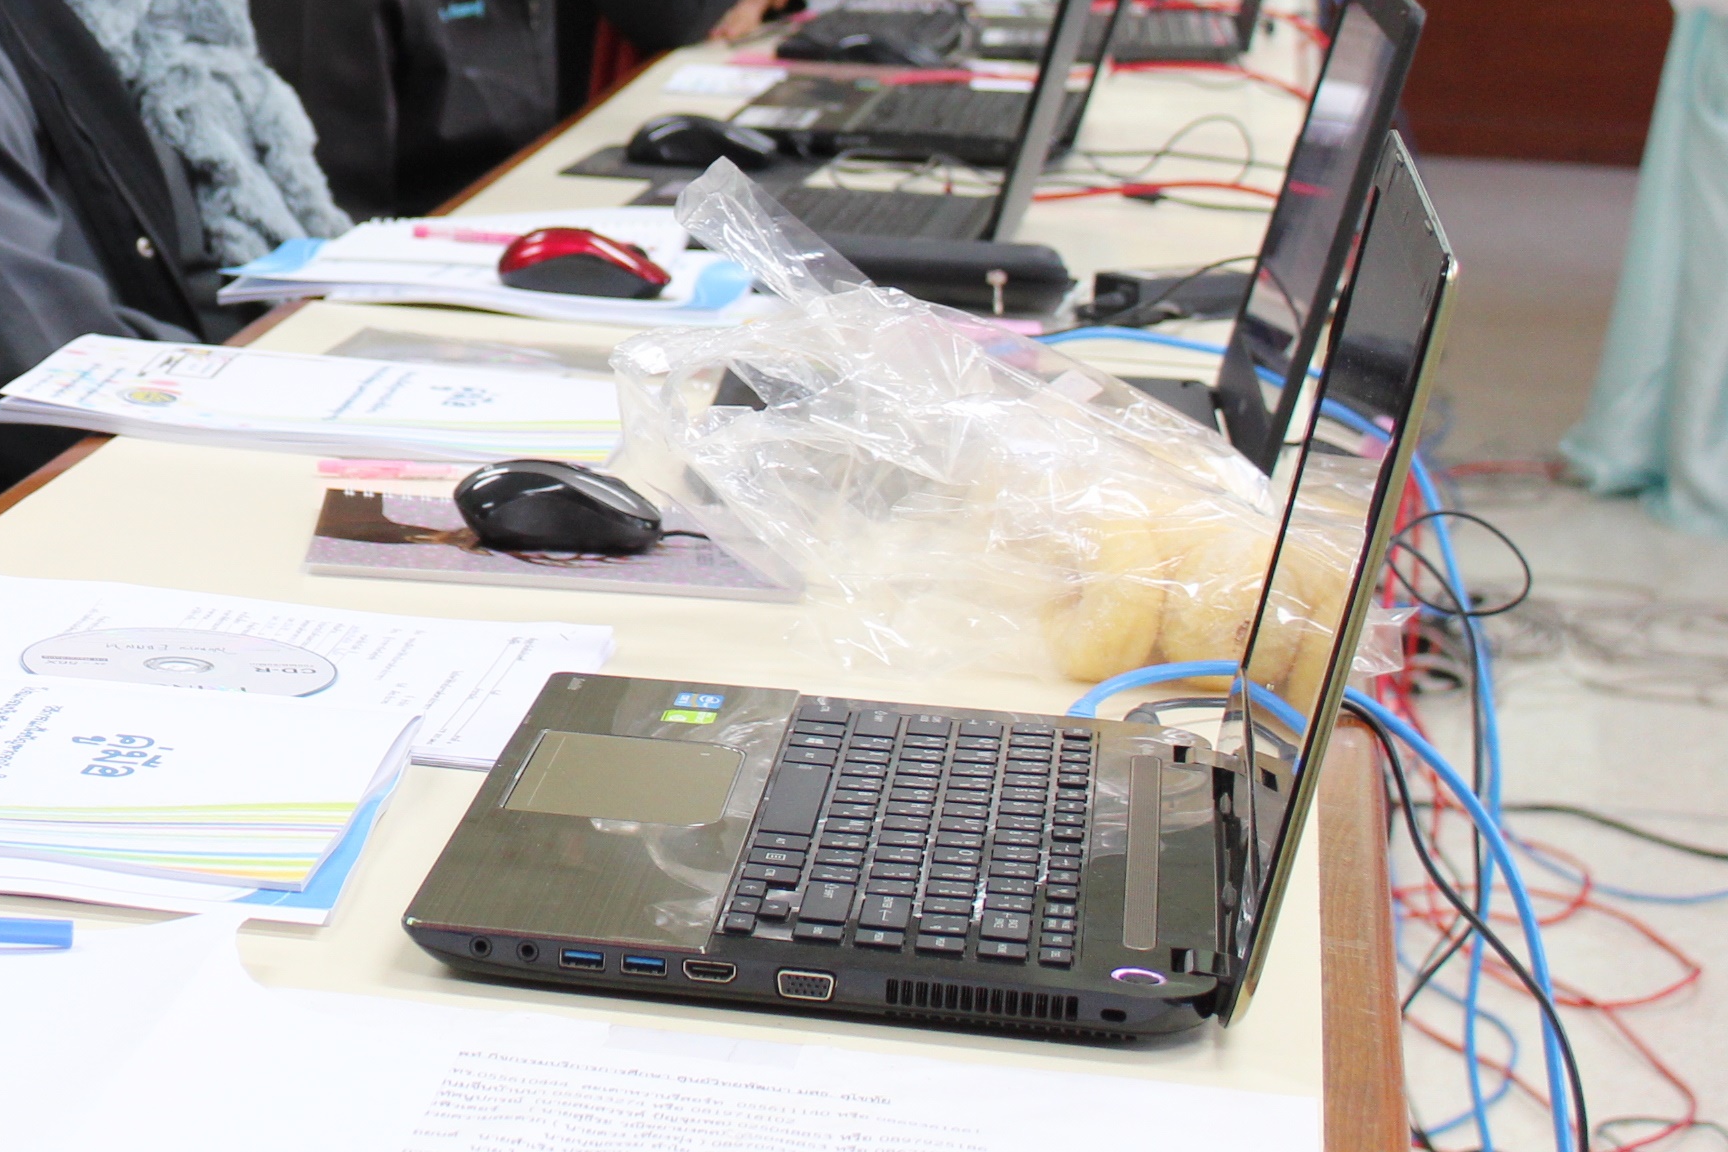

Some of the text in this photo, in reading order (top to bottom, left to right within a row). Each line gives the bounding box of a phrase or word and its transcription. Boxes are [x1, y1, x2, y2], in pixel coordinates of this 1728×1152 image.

[254, 666, 317, 676] CD-R
[72, 732, 174, 778] คู่มือ
